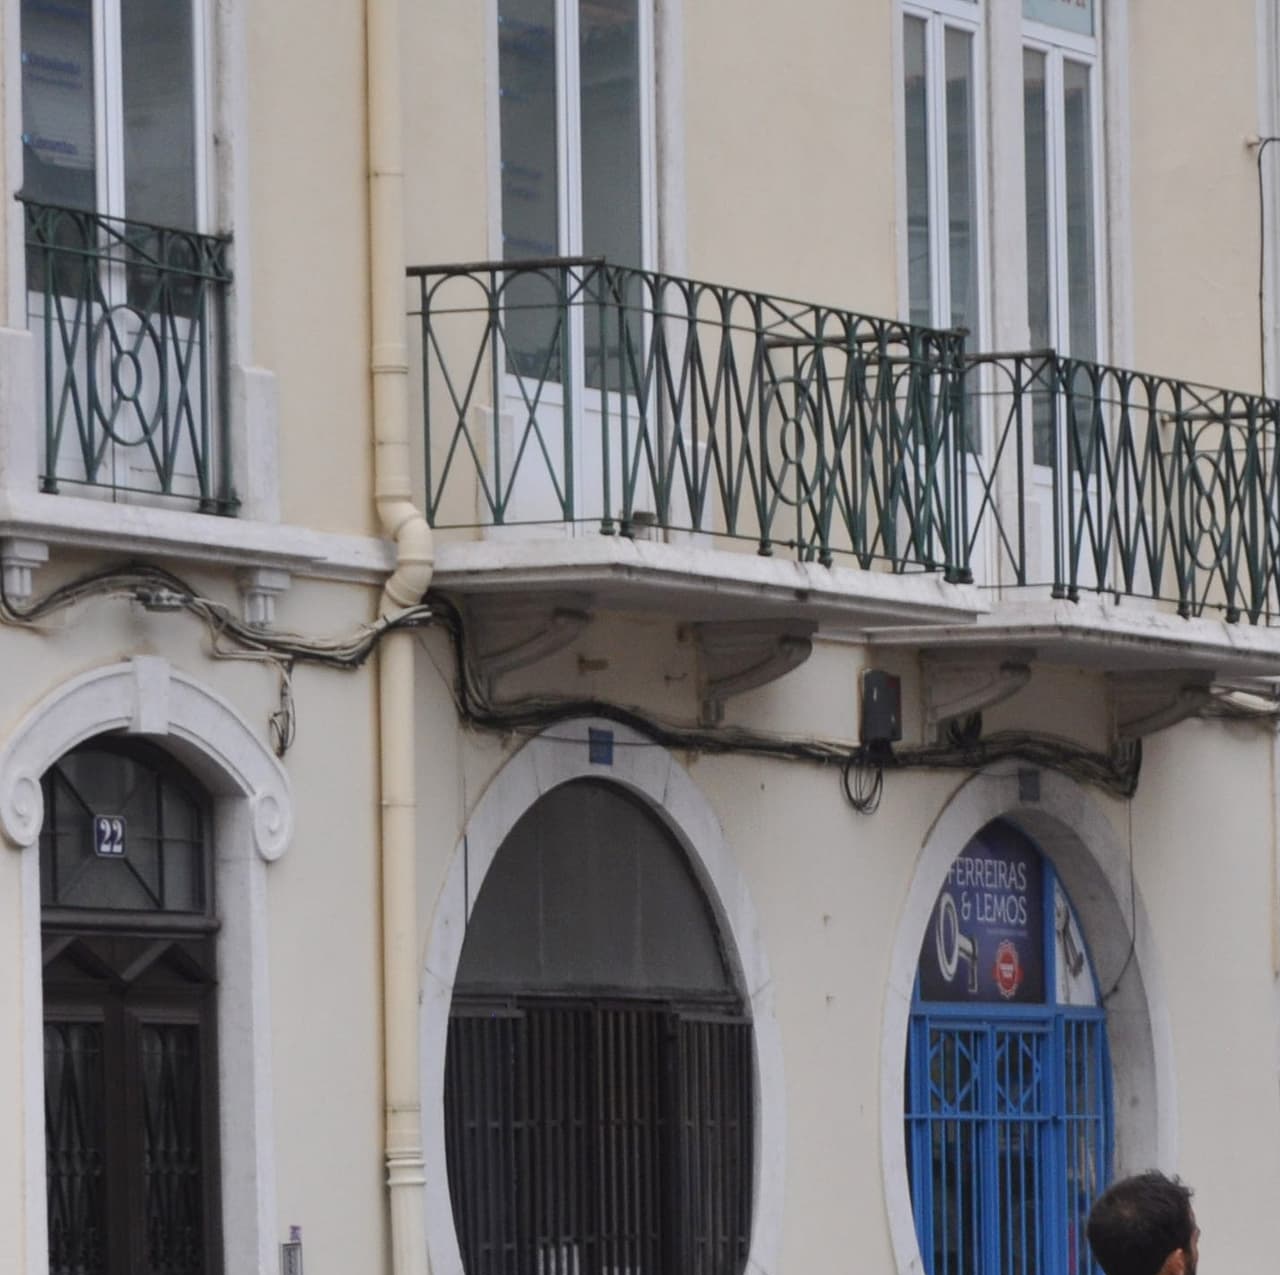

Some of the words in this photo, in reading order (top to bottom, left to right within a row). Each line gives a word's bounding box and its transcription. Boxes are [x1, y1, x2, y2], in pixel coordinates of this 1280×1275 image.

[100, 818, 122, 853] 22
[961, 891, 972, 921] &
[976, 893, 1027, 925] LEMOS
